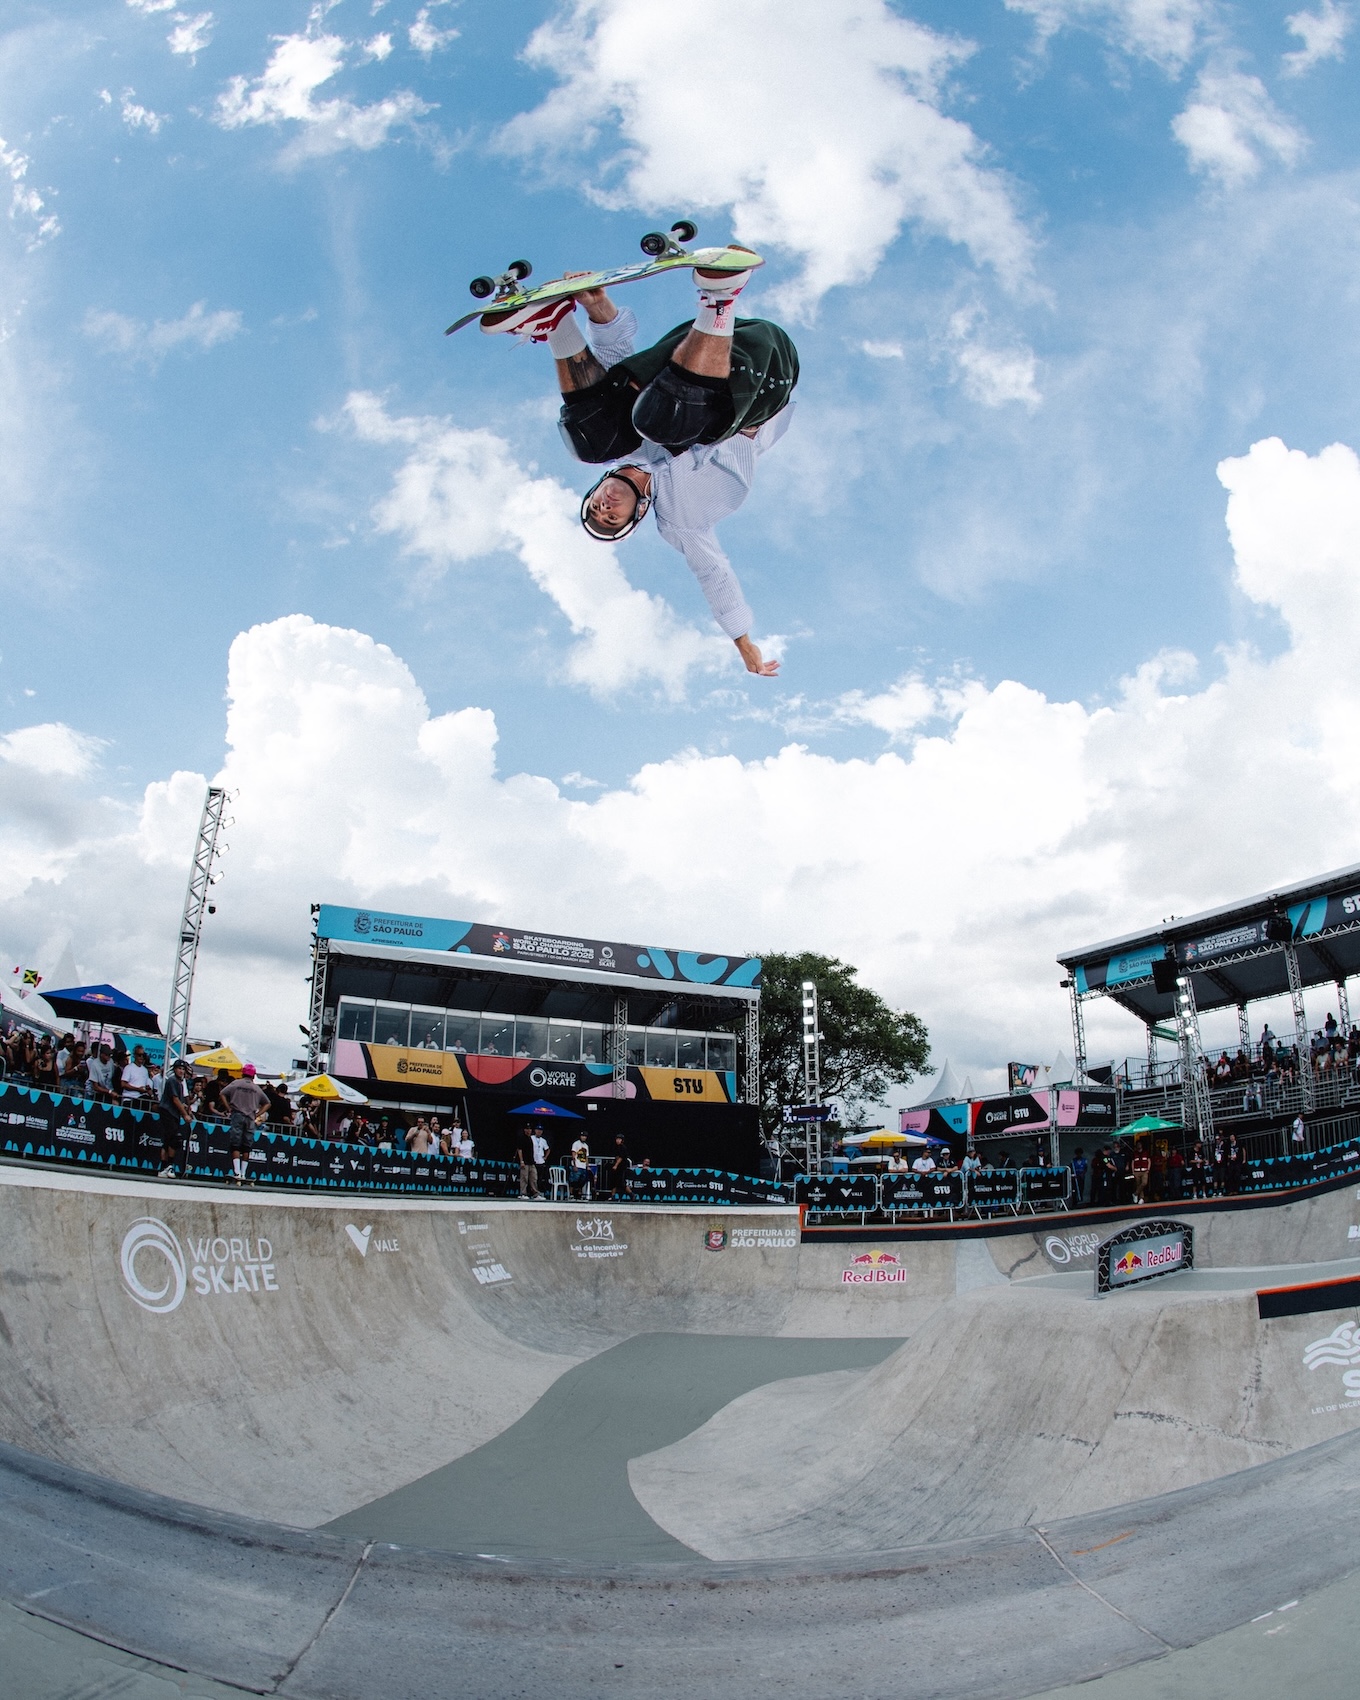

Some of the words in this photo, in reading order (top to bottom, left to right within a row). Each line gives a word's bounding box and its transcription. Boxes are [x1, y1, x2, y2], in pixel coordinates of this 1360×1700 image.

[373, 917, 413, 927] PREFEITURA
[373, 924, 392, 934] SÃO
[393, 927, 423, 937] PAULO
[512, 938, 538, 946] WORLD
[539, 942, 594, 954] CHAMPIONSHIPS
[523, 935, 584, 948] SKATEBOARDING
[1214, 937, 1238, 949] PAULO
[1239, 933, 1257, 942] 2025
[512, 943, 535, 951] SÃO
[536, 946, 570, 956] PAULO
[570, 950, 594, 960] 2025
[547, 1070, 576, 1081] WORLD
[547, 1077, 576, 1087] SKATE
[674, 1077, 703, 1094] STU
[1014, 1107, 1029, 1119] STU
[953, 1117, 962, 1125] STU
[105, 1127, 125, 1142] STU
[1252, 1170, 1264, 1179] STU
[652, 1180, 666, 1188] STU
[709, 1181, 723, 1191] STU
[934, 1185, 950, 1195] STU
[731, 1228, 785, 1237] PREFEITURA
[786, 1228, 796, 1236] DE
[374, 1239, 400, 1252] VALE
[730, 1235, 755, 1248] SÃO
[757, 1237, 796, 1248] PAULO
[1064, 1233, 1099, 1246] WORLD
[187, 1237, 273, 1263] WORLD
[593, 1243, 628, 1251] Incentivo
[588, 1251, 618, 1259] Esporte
[192, 1263, 279, 1295] SKATE
[472, 1263, 513, 1285] BRASIL
[842, 1269, 873, 1284] Red
[875, 1268, 907, 1283] Bull
[1326, 1404, 1338, 1412] DE
